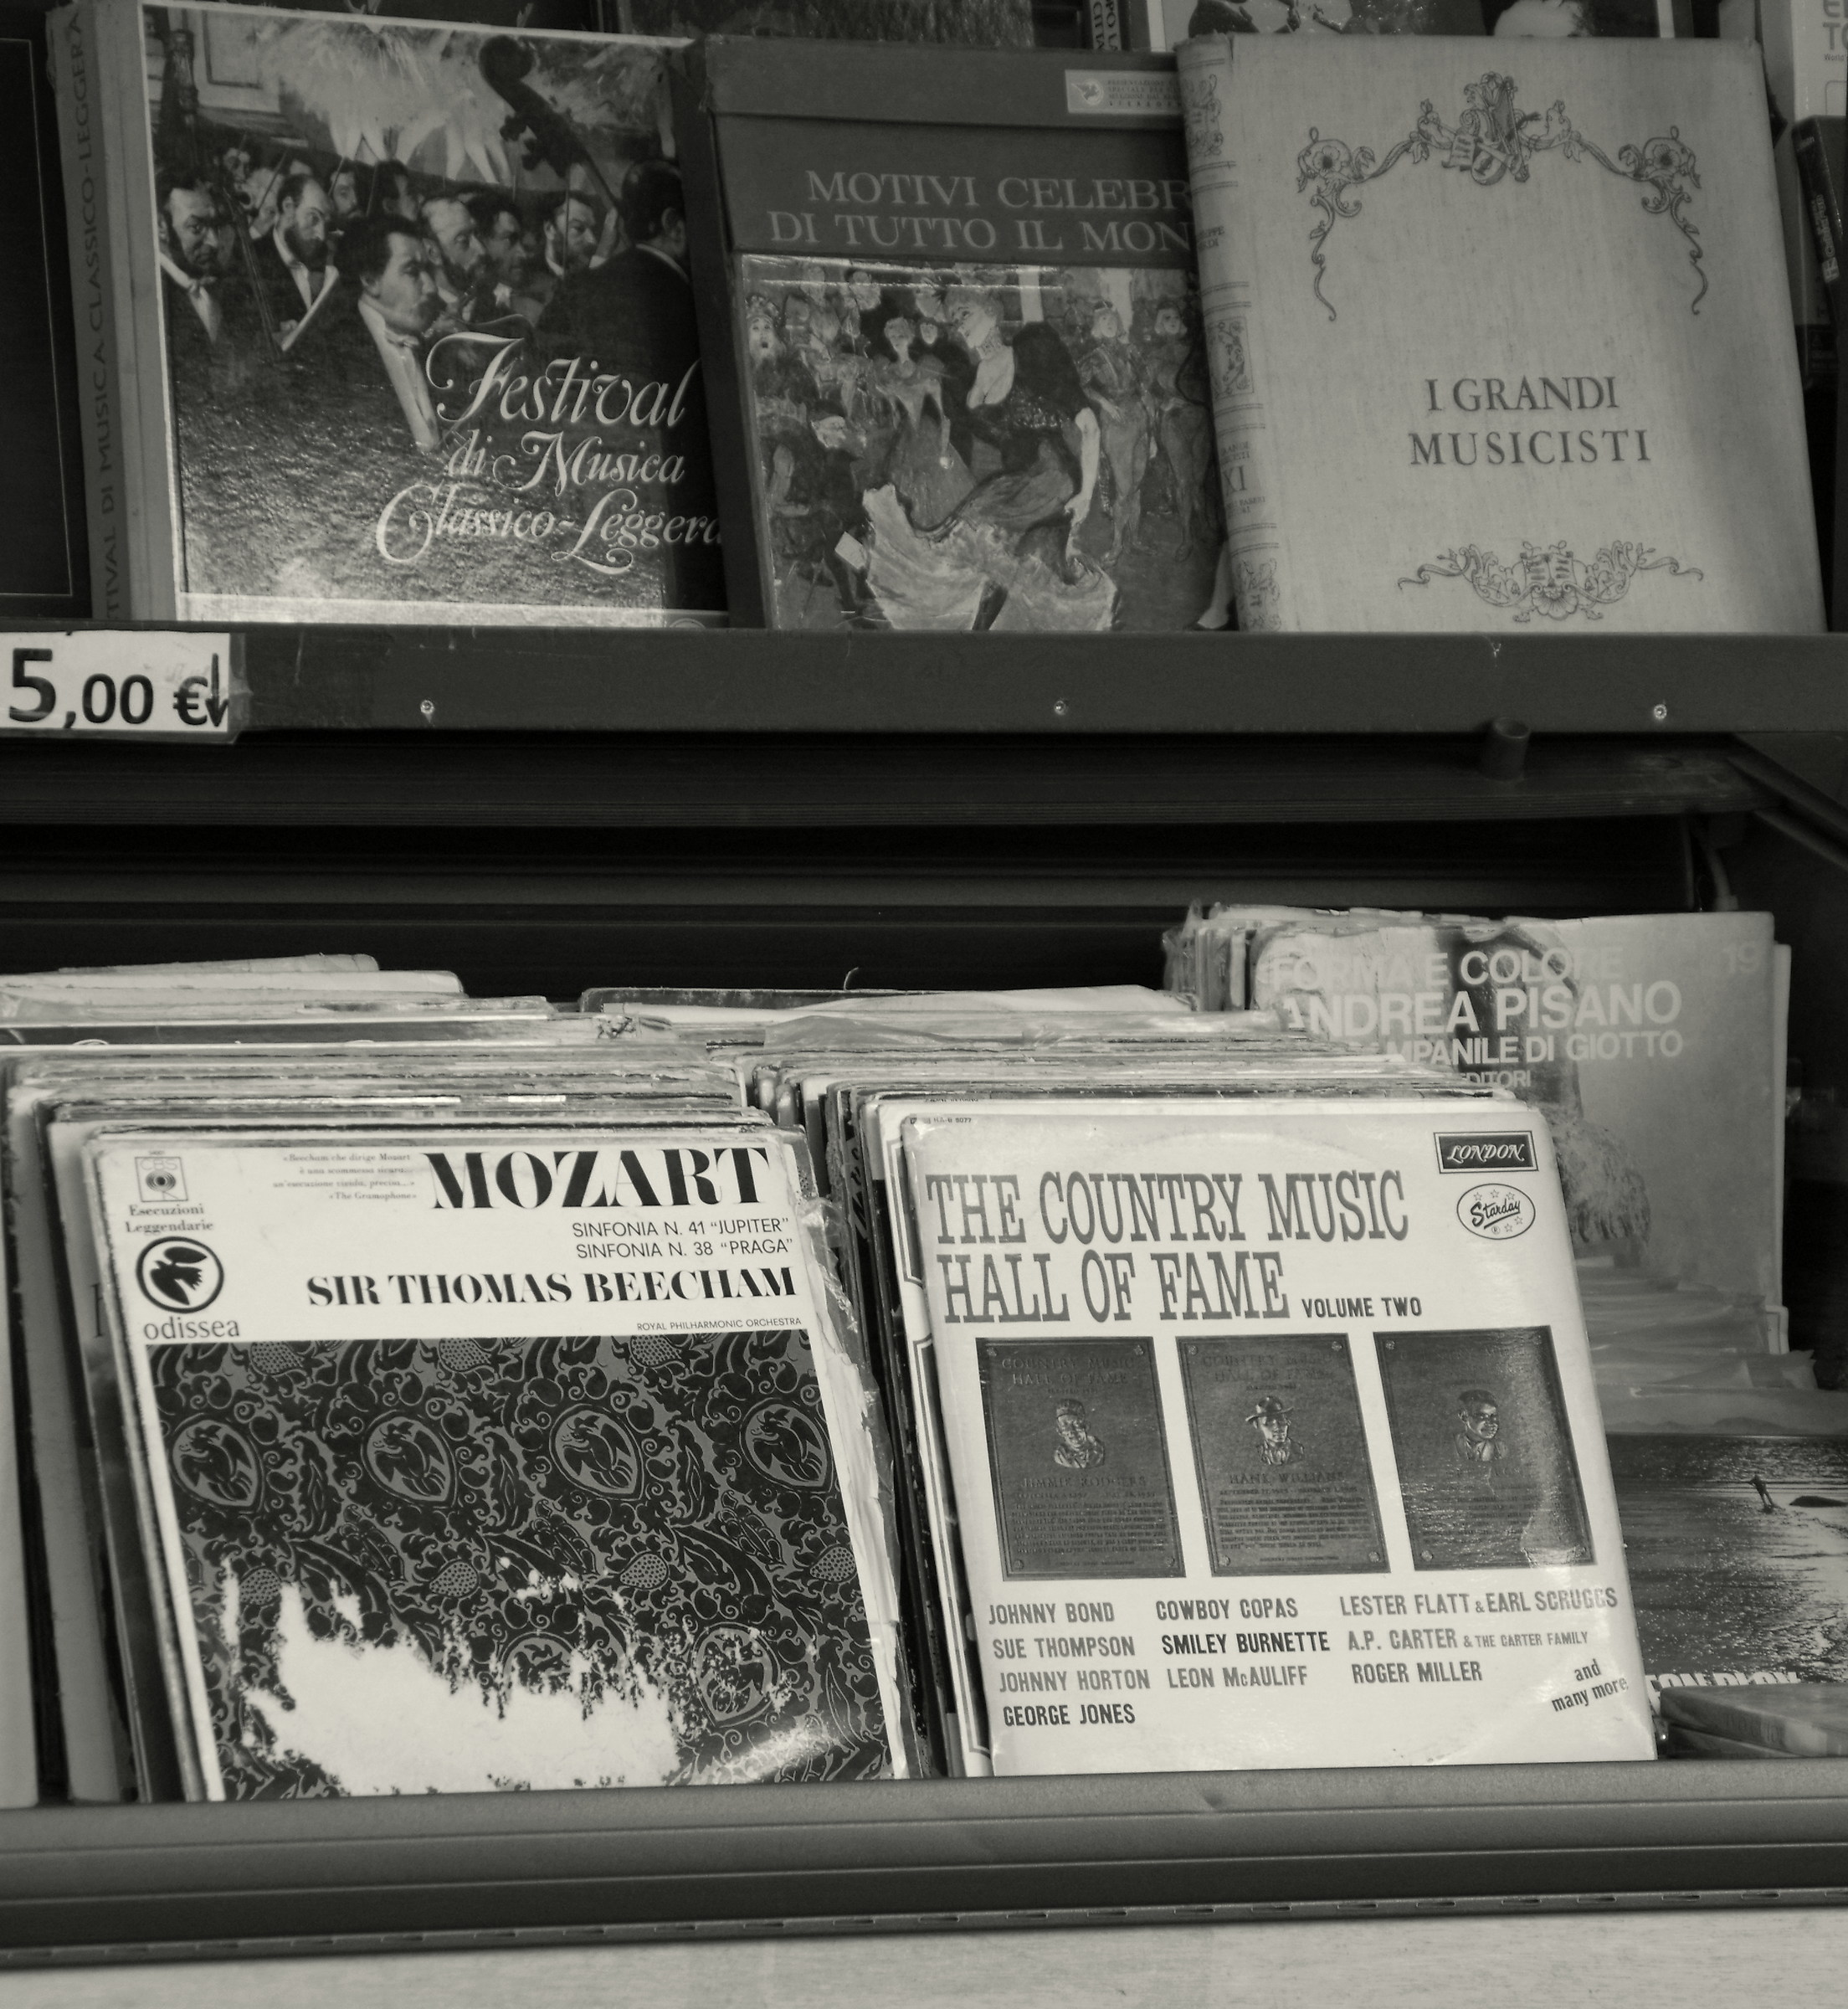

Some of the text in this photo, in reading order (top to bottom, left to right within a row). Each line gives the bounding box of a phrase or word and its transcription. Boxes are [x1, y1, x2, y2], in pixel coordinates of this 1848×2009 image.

[806, 170, 979, 207] MOTIVI
[767, 211, 820, 244] DI
[835, 214, 997, 249] TUTTO
[1015, 219, 1064, 250] IL
[426, 331, 701, 427] Festival
[93, 342, 112, 471] MUSICA
[1424, 376, 1620, 412] I GRANDI
[1408, 429, 1651, 465] MUSICISTI
[447, 429, 685, 497] di Musica
[100, 484, 115, 515] DI
[8, 648, 208, 728] 5,00 €
[1271, 947, 1624, 990] FORMA E COLORE
[1496, 980, 1682, 1030] PISANO
[1348, 1030, 1684, 1066] MPANILE DI GIOTTO
[1461, 1070, 1531, 1088] DITORI
[140, 1159, 179, 1171] CBS
[379, 1153, 410, 1161] Mozart
[1447, 1143, 1525, 1164] LONDON
[421, 1147, 770, 1209] MOZART
[129, 1203, 204, 1217] Esecuzioni
[925, 1174, 1027, 1245] THE
[1040, 1171, 1246, 1246] COUNTRY
[1258, 1169, 1409, 1243] MUSIC
[1471, 1198, 1521, 1228] Starday
[126, 1220, 213, 1236] Leggendarie
[572, 1221, 658, 1238] SINFONIA
[665, 1220, 683, 1236] N.
[689, 1220, 705, 1236] 41
[576, 1242, 663, 1259] SINFONIA
[669, 1241, 687, 1256] N.
[694, 1241, 713, 1256] 38
[306, 1267, 797, 1306] SIR THOMAS BEECHAM
[937, 1249, 1423, 1323] HALL OF FAME VOLUME TWO
[143, 1316, 240, 1340] odissea
[637, 1318, 802, 1331] ROYAL PHILHARMONIC ORCHESTRA
[988, 1601, 1115, 1626] JOHNNY BOND
[1156, 1597, 1299, 1621] COWBOY COPAS
[1339, 1595, 1407, 1616] LESTER
[1414, 1593, 1471, 1615] FLATT
[1476, 1601, 1485, 1613] &
[1486, 1591, 1531, 1613] EARL
[993, 1636, 1136, 1659] SUE THOMPSON
[1162, 1631, 1331, 1656] SMILEY BURNETTE
[1348, 1628, 1589, 1651] A.P. CARTER & THE CARTER FAMILY
[999, 1669, 1151, 1693] JOHNNY HORTON
[1168, 1665, 1307, 1689] LEON McAULIFF
[1352, 1661, 1483, 1684] ROGER MILLER
[1573, 1658, 1602, 1682] and
[1551, 1688, 1590, 1713] many
[1003, 1703, 1136, 1726] GEORGE JONES
